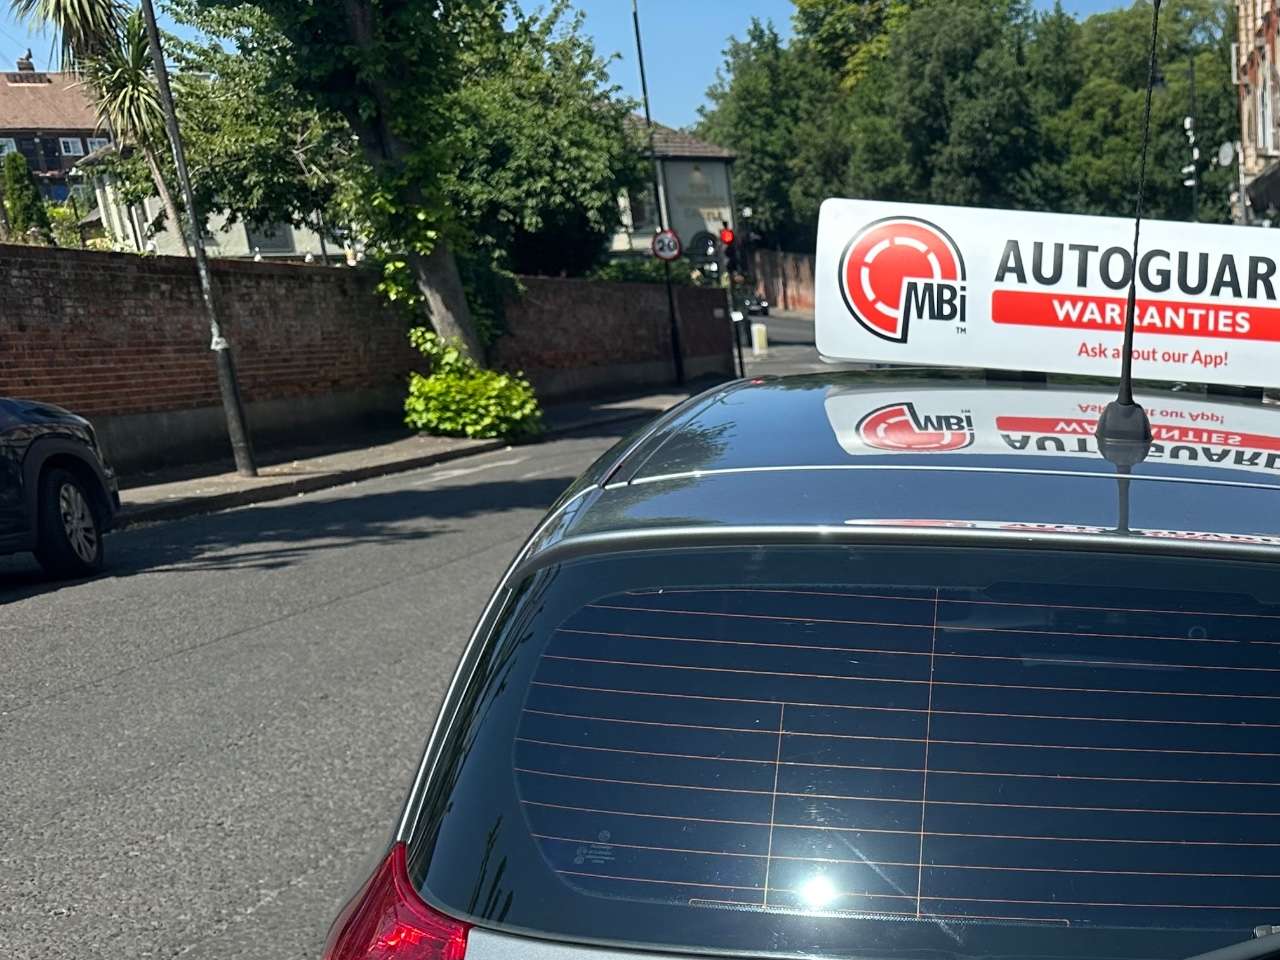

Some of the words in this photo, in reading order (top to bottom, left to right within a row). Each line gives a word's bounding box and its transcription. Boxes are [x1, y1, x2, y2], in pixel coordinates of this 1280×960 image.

[657, 239, 677, 252] 20
[902, 281, 967, 325] MBi
[1078, 342, 1108, 359] Ask
[1112, 348, 1158, 362] aout
[1161, 352, 1188, 365] our
[1191, 350, 1229, 369] App!
